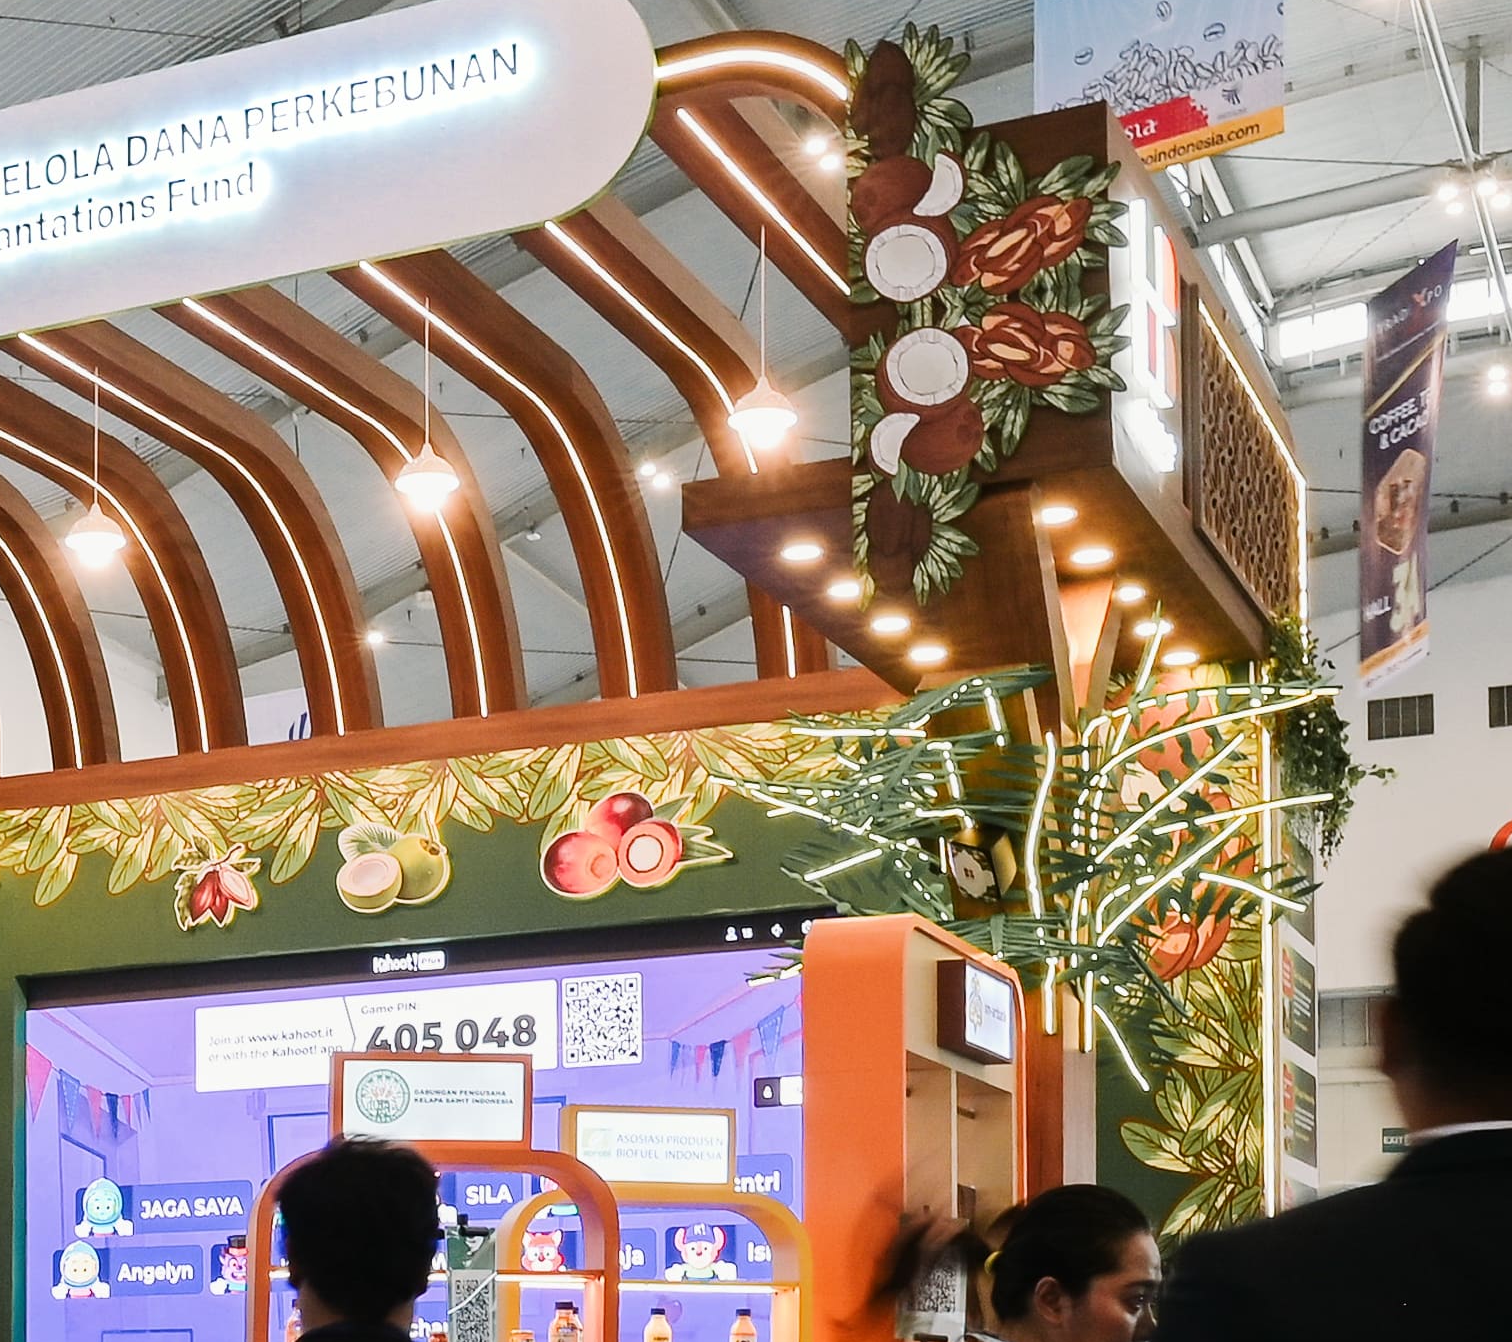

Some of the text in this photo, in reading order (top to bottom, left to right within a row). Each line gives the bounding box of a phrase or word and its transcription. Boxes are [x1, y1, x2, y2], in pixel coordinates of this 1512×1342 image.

[126, 114, 232, 168] DANA
[244, 42, 518, 140] PERKEBUNAN
[167, 161, 255, 212] Fund
[372, 952, 419, 975] Kahoot!
[360, 1004, 394, 1015] Game
[247, 1026, 334, 1044] www.kahoot.it
[366, 1013, 537, 1054] 405 048
[615, 1134, 724, 1147] ASOSIASI PRODUSEN
[1383, 1136, 1404, 1146] EXIT
[615, 1148, 659, 1160] BIOFUEL
[664, 1149, 723, 1161] INDONESIA
[464, 1183, 515, 1207] SILA
[140, 1195, 244, 1220] JAGA SAYA
[117, 1260, 194, 1286] Angelyn
